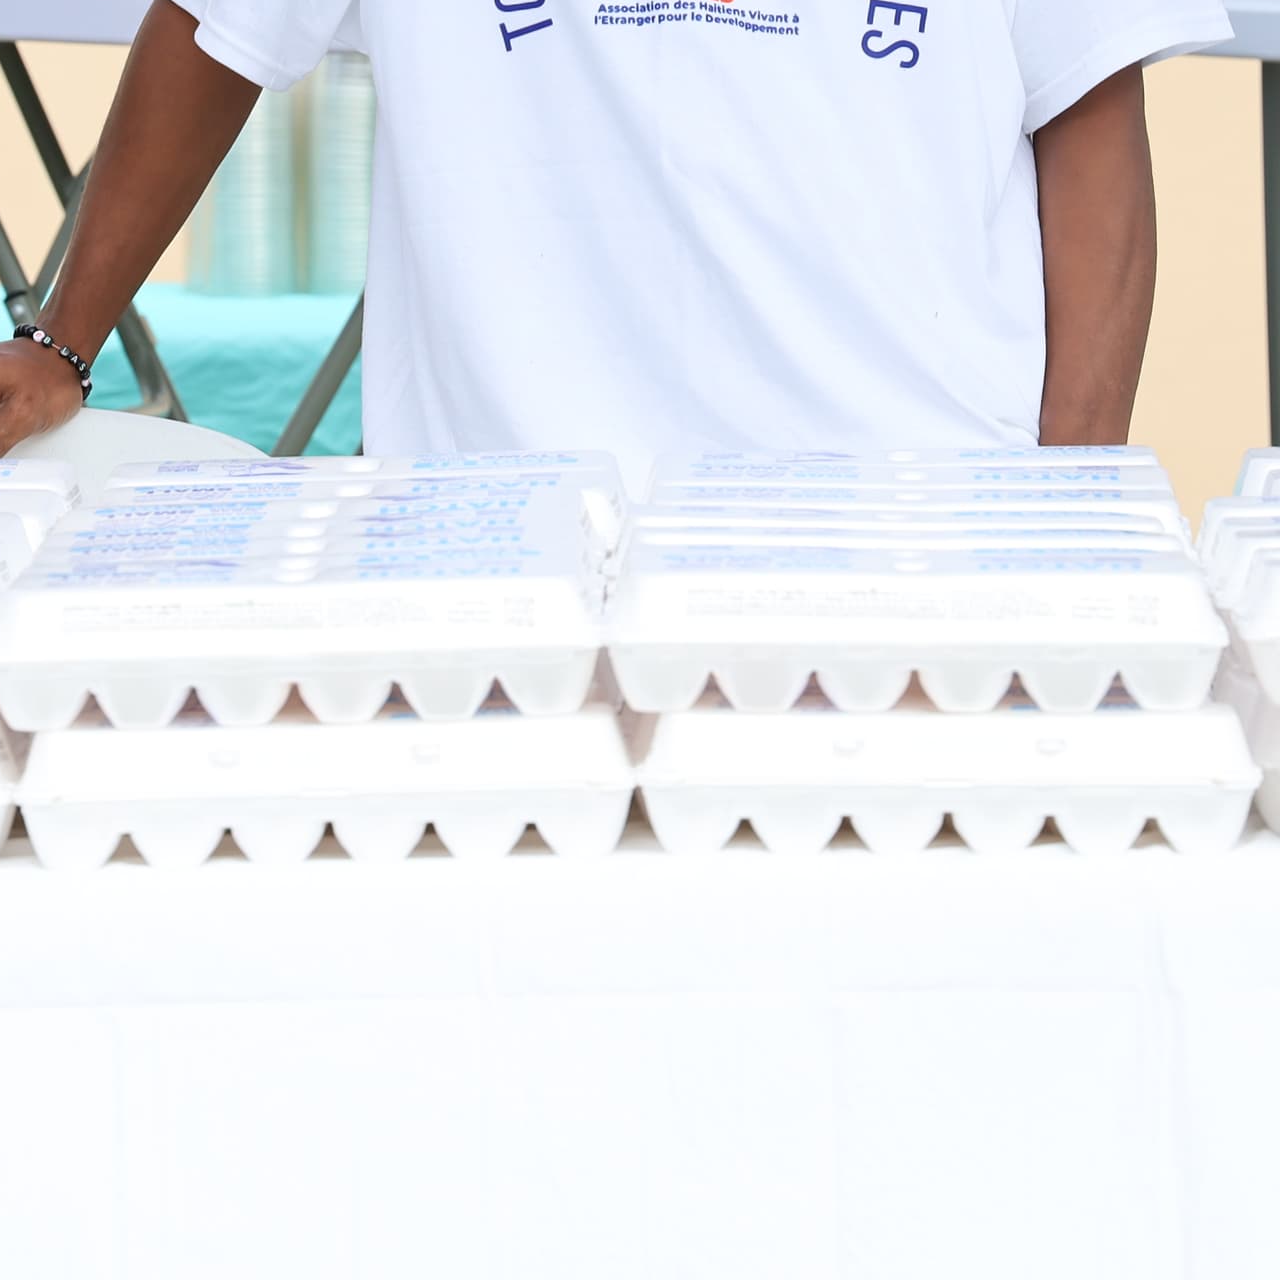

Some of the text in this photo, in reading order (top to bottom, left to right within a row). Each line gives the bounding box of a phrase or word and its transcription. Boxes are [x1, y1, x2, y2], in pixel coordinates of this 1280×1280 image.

[597, 0, 670, 14] Association
[673, 0, 696, 10] des
[748, 10, 789, 24] Vivant
[657, 12, 688, 25] pour
[691, 11, 703, 22] le
